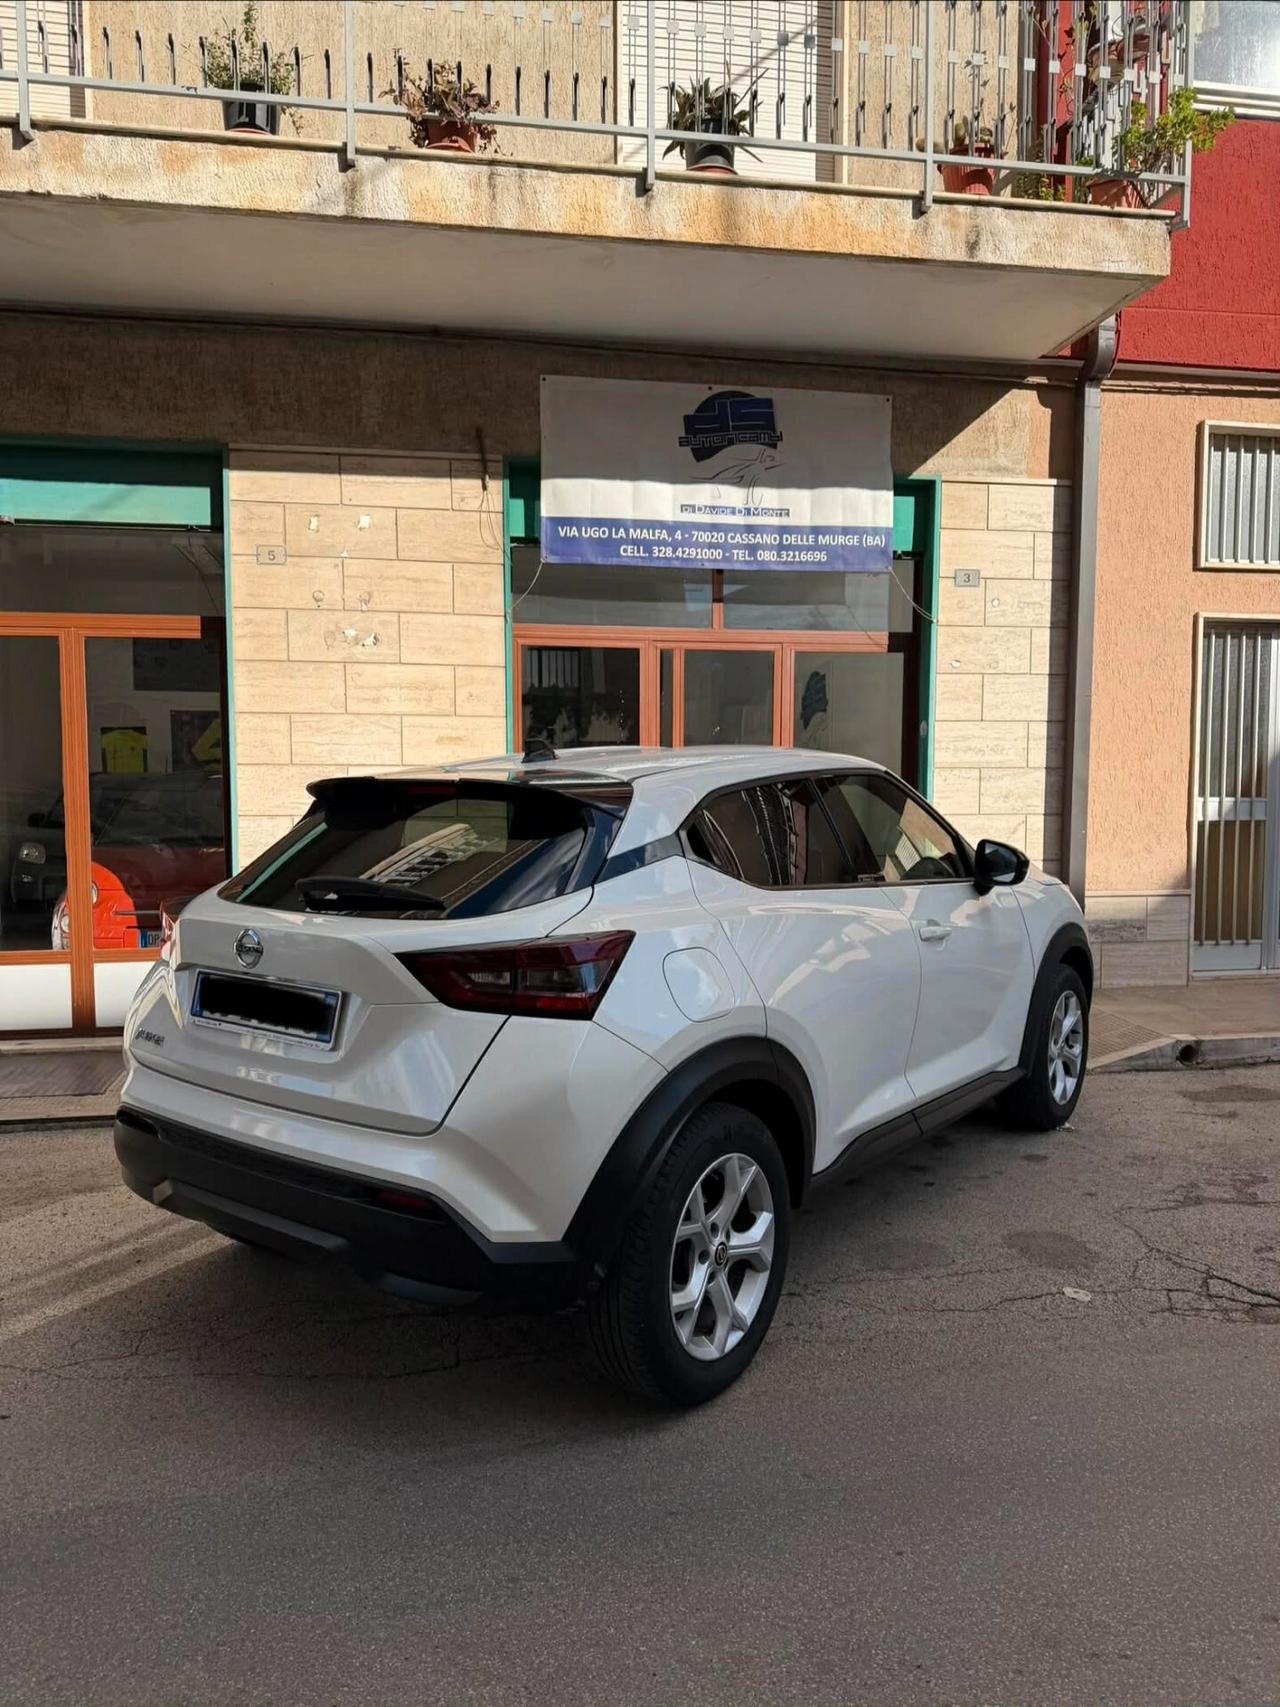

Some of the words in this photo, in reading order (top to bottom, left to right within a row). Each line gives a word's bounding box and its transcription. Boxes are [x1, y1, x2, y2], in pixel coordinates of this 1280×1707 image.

[558, 526, 579, 538] VIA
[581, 526, 609, 538] UGO
[612, 527, 626, 539] LA
[629, 528, 672, 542] MALFA,
[674, 529, 682, 540] 4
[691, 531, 725, 543] 70020
[727, 533, 780, 545] CASSANO
[783, 534, 815, 546] DELLE
[818, 535, 860, 546] MURGE
[862, 534, 886, 547] (BA)
[267, 550, 276, 561] 5
[619, 545, 649, 557] CELL.
[652, 546, 723, 560] 328.4291000
[732, 549, 754, 561] TEL.
[757, 550, 827, 562] 080.3216696
[963, 573, 971, 583] 3
